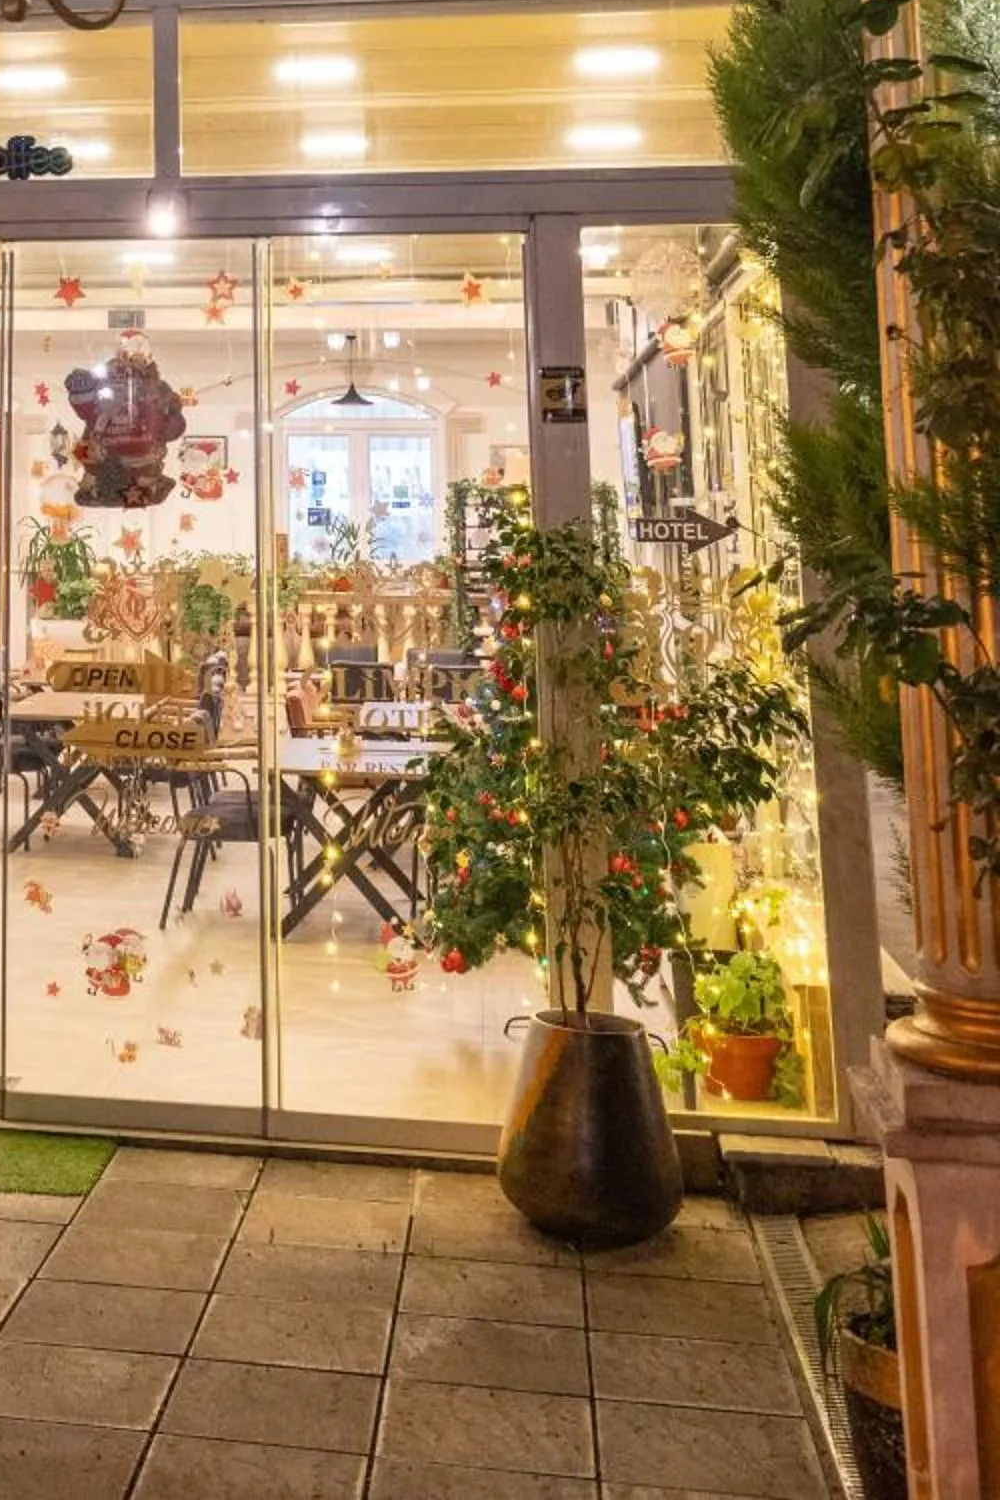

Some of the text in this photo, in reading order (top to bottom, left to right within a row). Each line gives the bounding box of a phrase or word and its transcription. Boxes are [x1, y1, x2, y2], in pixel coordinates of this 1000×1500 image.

[639, 521, 709, 540] HOTEL
[70, 666, 136, 688] OPEN
[114, 728, 198, 751] CLOSE
